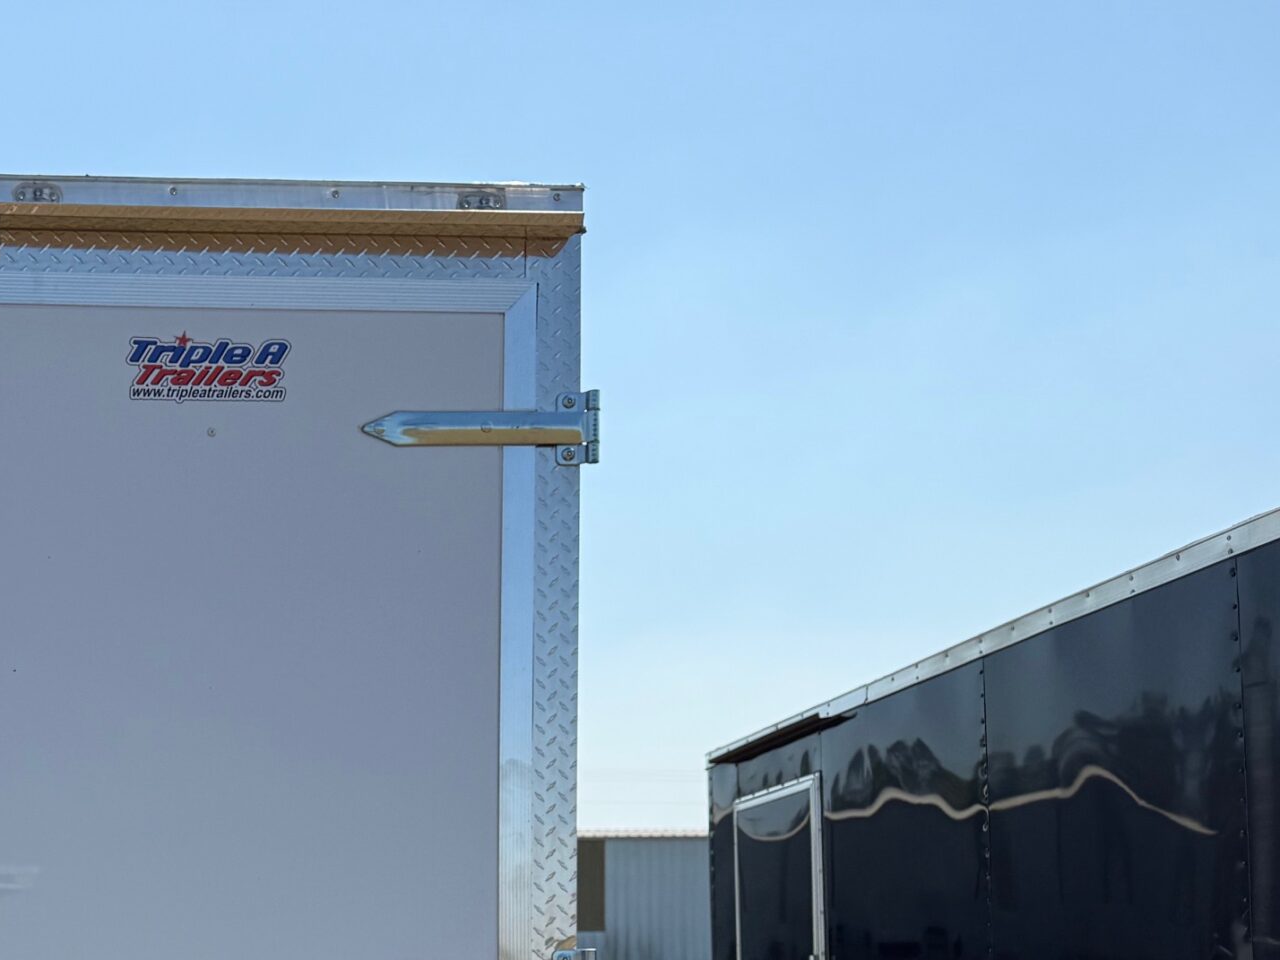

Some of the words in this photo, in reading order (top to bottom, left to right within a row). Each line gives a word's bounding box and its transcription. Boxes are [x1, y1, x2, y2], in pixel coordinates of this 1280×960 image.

[128, 339, 251, 368] Triple
[254, 341, 289, 365] A
[136, 365, 281, 387] Trailers
[132, 387, 283, 400] www.tripleatrailers.com
